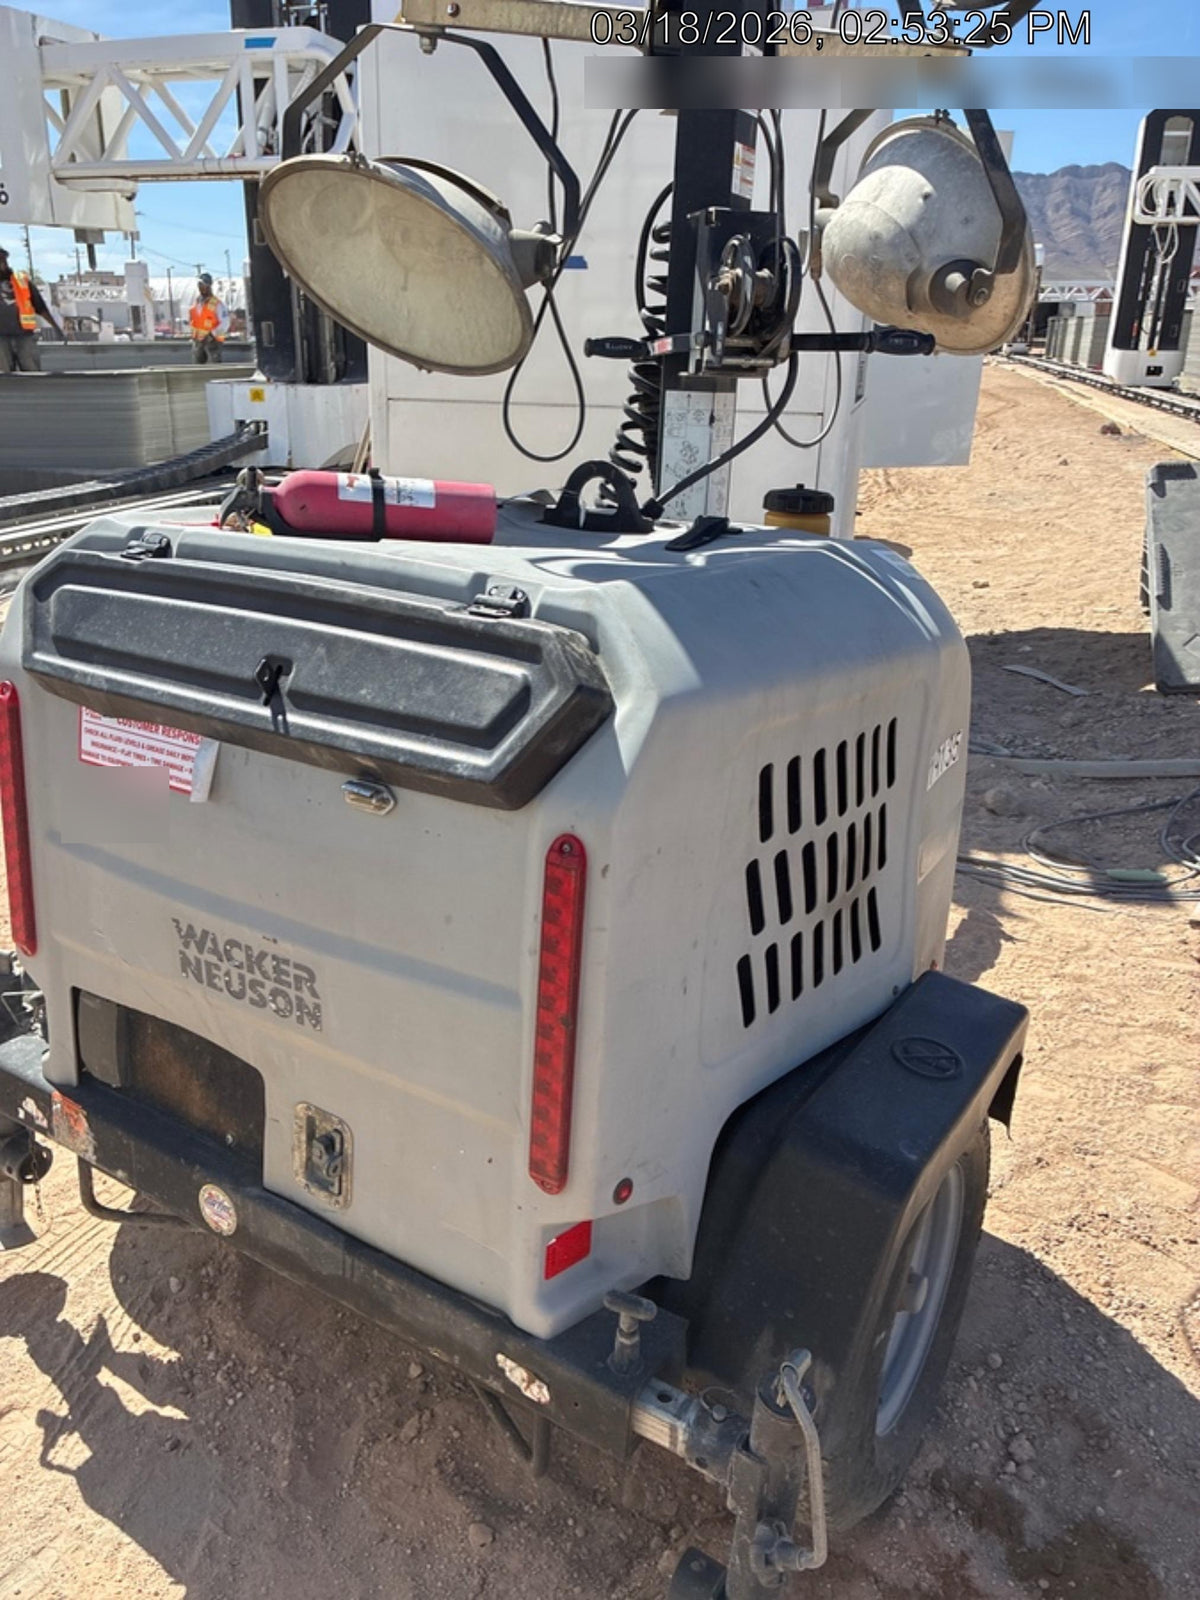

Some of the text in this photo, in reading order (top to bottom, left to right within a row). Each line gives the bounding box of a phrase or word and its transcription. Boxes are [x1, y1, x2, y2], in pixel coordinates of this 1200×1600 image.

[117, 717, 160, 734] CUSTOMER
[84, 727, 99, 737] CHECK
[100, 731, 109, 740] ALL
[109, 734, 123, 743] FLUID
[124, 739, 140, 749] LEVELS
[146, 745, 165, 755] GREASE
[166, 749, 180, 759] DAILY
[132, 752, 146, 762] TIRES
[171, 917, 320, 999] WACKER
[178, 949, 322, 1032] NEUSON
